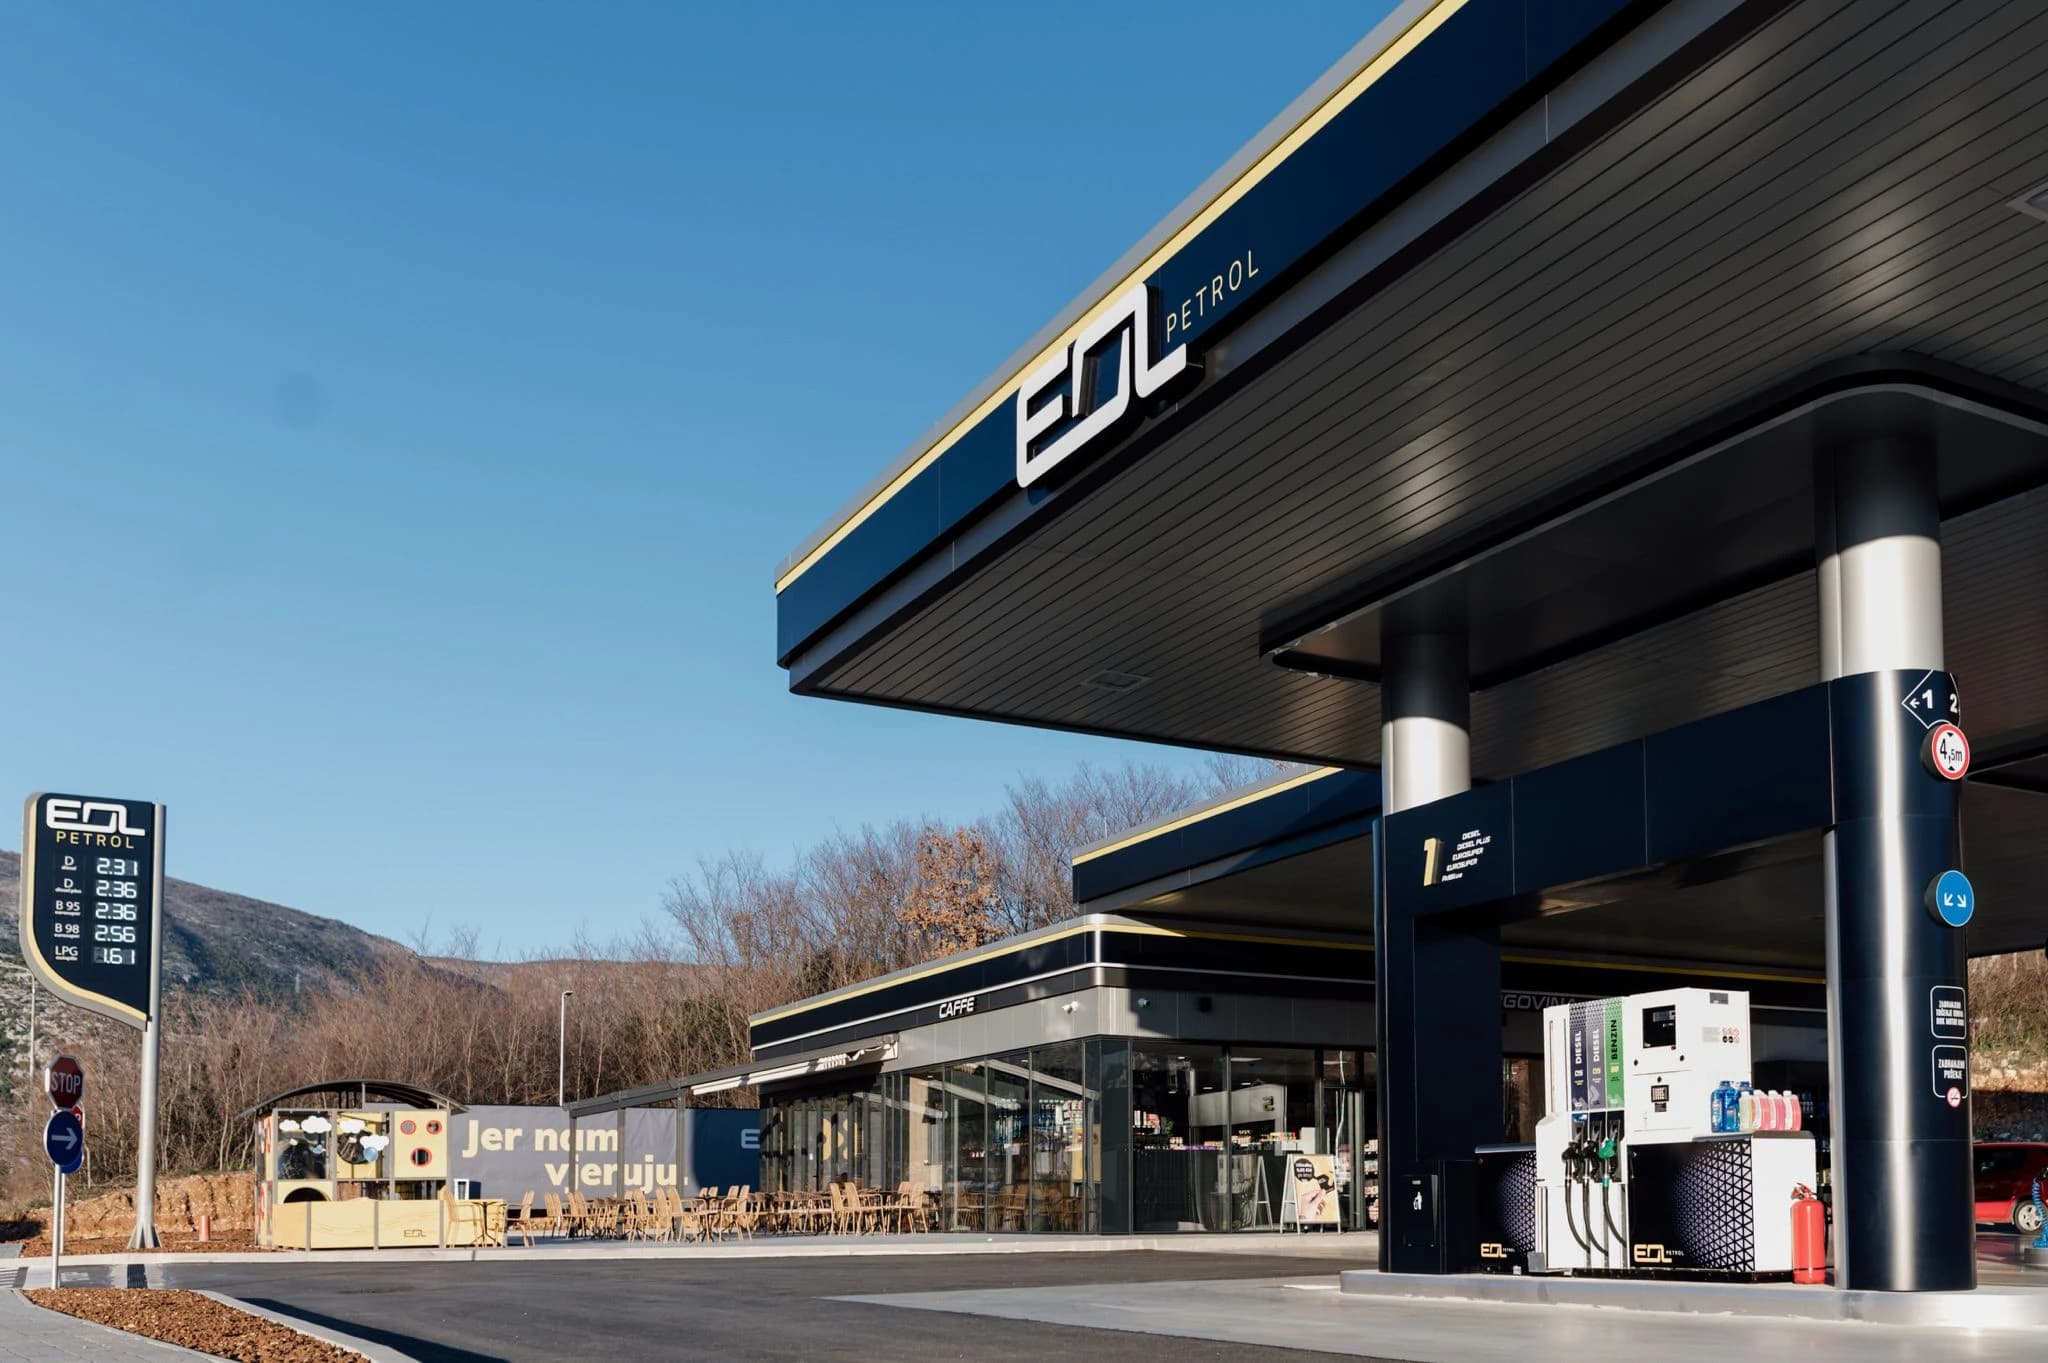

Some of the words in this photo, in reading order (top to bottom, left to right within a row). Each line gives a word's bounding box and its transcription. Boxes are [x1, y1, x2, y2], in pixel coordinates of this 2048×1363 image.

[1166, 250, 1259, 343] PETROL
[1921, 689, 1933, 709] 1
[1949, 693, 1959, 714] 2
[56, 831, 134, 849] PETROL
[64, 855, 75, 866] D
[96, 857, 138, 876] 2.31
[1423, 837, 1439, 887] 1
[63, 878, 74, 889] D
[96, 879, 137, 899] 2.36
[55, 900, 64, 911] B
[66, 901, 80, 912] 95
[95, 902, 137, 921] 2.36
[54, 923, 63, 933] B
[65, 923, 80, 934] 98
[94, 924, 136, 943] 2.56
[55, 945, 79, 956] LPG
[103, 947, 136, 965] 1.61
[939, 996, 975, 1019] CAFFE
[1574, 1031, 1582, 1064] DIESEL
[1610, 1019, 1618, 1060] BENZIN
[50, 1071, 82, 1095] STOP
[462, 1119, 523, 1158] Jer
[534, 1127, 618, 1152] nam
[1665, 1249, 1685, 1257] PETROL
